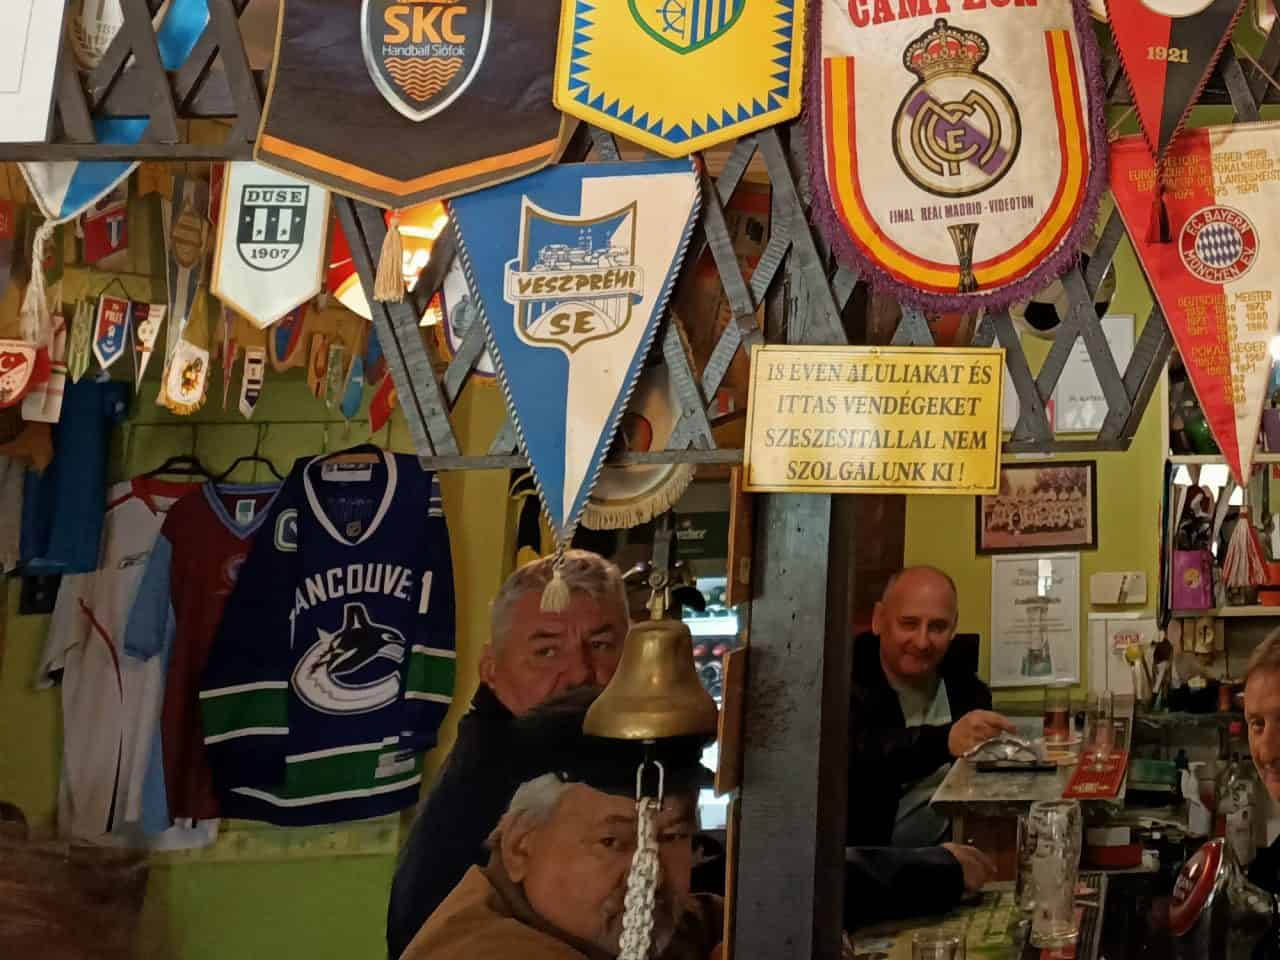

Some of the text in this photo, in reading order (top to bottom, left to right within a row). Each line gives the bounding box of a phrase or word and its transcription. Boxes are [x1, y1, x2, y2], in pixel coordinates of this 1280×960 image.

[383, 6, 469, 43] SKC
[382, 43, 430, 57] Handball
[1146, 46, 1189, 64] 1921
[246, 189, 303, 203] DUSE
[888, 206, 915, 225] FINAL
[920, 204, 942, 223] REAL
[944, 201, 982, 219] MADRID
[988, 195, 1035, 214] VIDEOTON
[1203, 207, 1250, 233] BAYERN
[250, 246, 291, 261] 1907
[516, 262, 636, 296] VESZPRÉMI
[549, 310, 597, 337] SE
[767, 362, 785, 381] 18
[846, 362, 964, 385] ALULIAKAT
[968, 359, 993, 385] ÉS
[776, 390, 982, 417] ITTAS VENDÉGEKET
[942, 430, 988, 450] NEM
[295, 562, 412, 617] ANCOUVE
